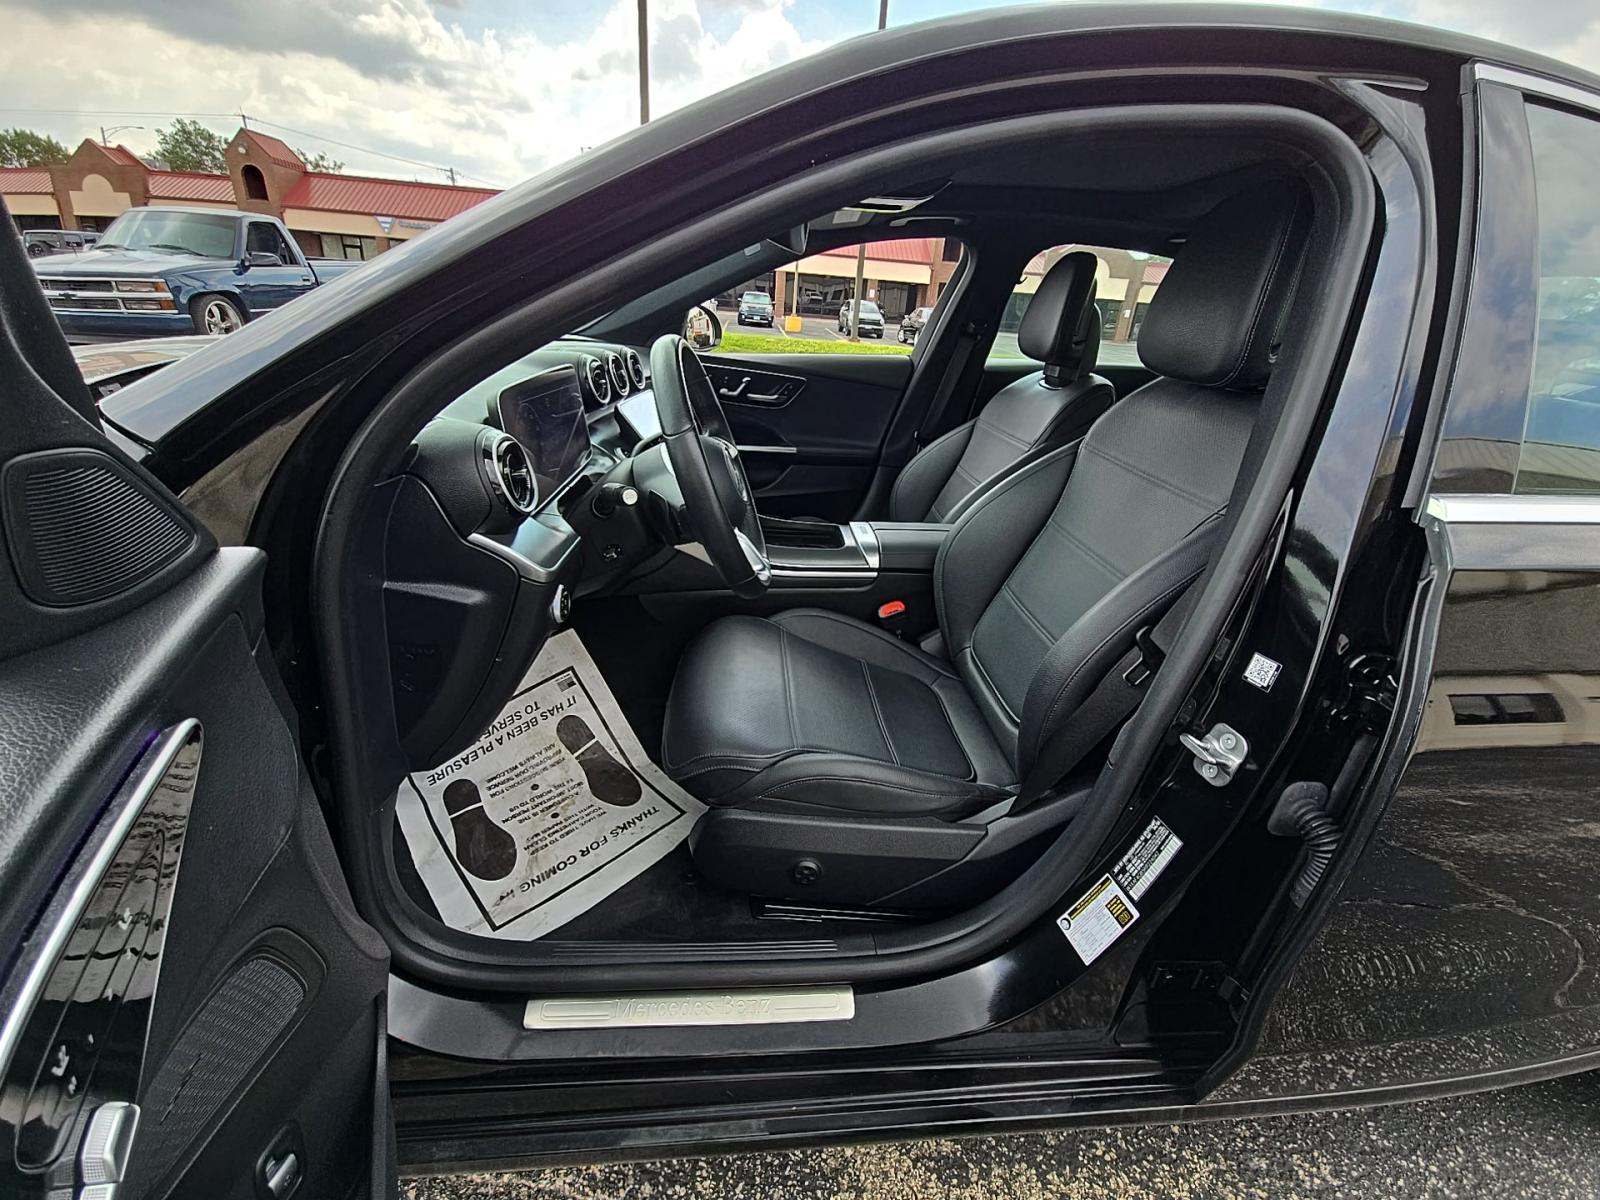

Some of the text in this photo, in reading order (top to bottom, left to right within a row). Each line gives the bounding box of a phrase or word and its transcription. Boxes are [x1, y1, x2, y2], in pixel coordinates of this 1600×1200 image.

[564, 694, 578, 707] IT
[480, 700, 541, 738] TO SERVE
[539, 702, 565, 721] HAS
[504, 716, 539, 740] BEEN
[494, 734, 506, 746] A
[425, 741, 494, 786] PLEASURE
[486, 775, 514, 791] SERVICE
[489, 788, 504, 798] FOR
[529, 788, 552, 802] WORLD
[501, 807, 529, 823] PERSON
[517, 804, 659, 893] THANKS FOR COMING
